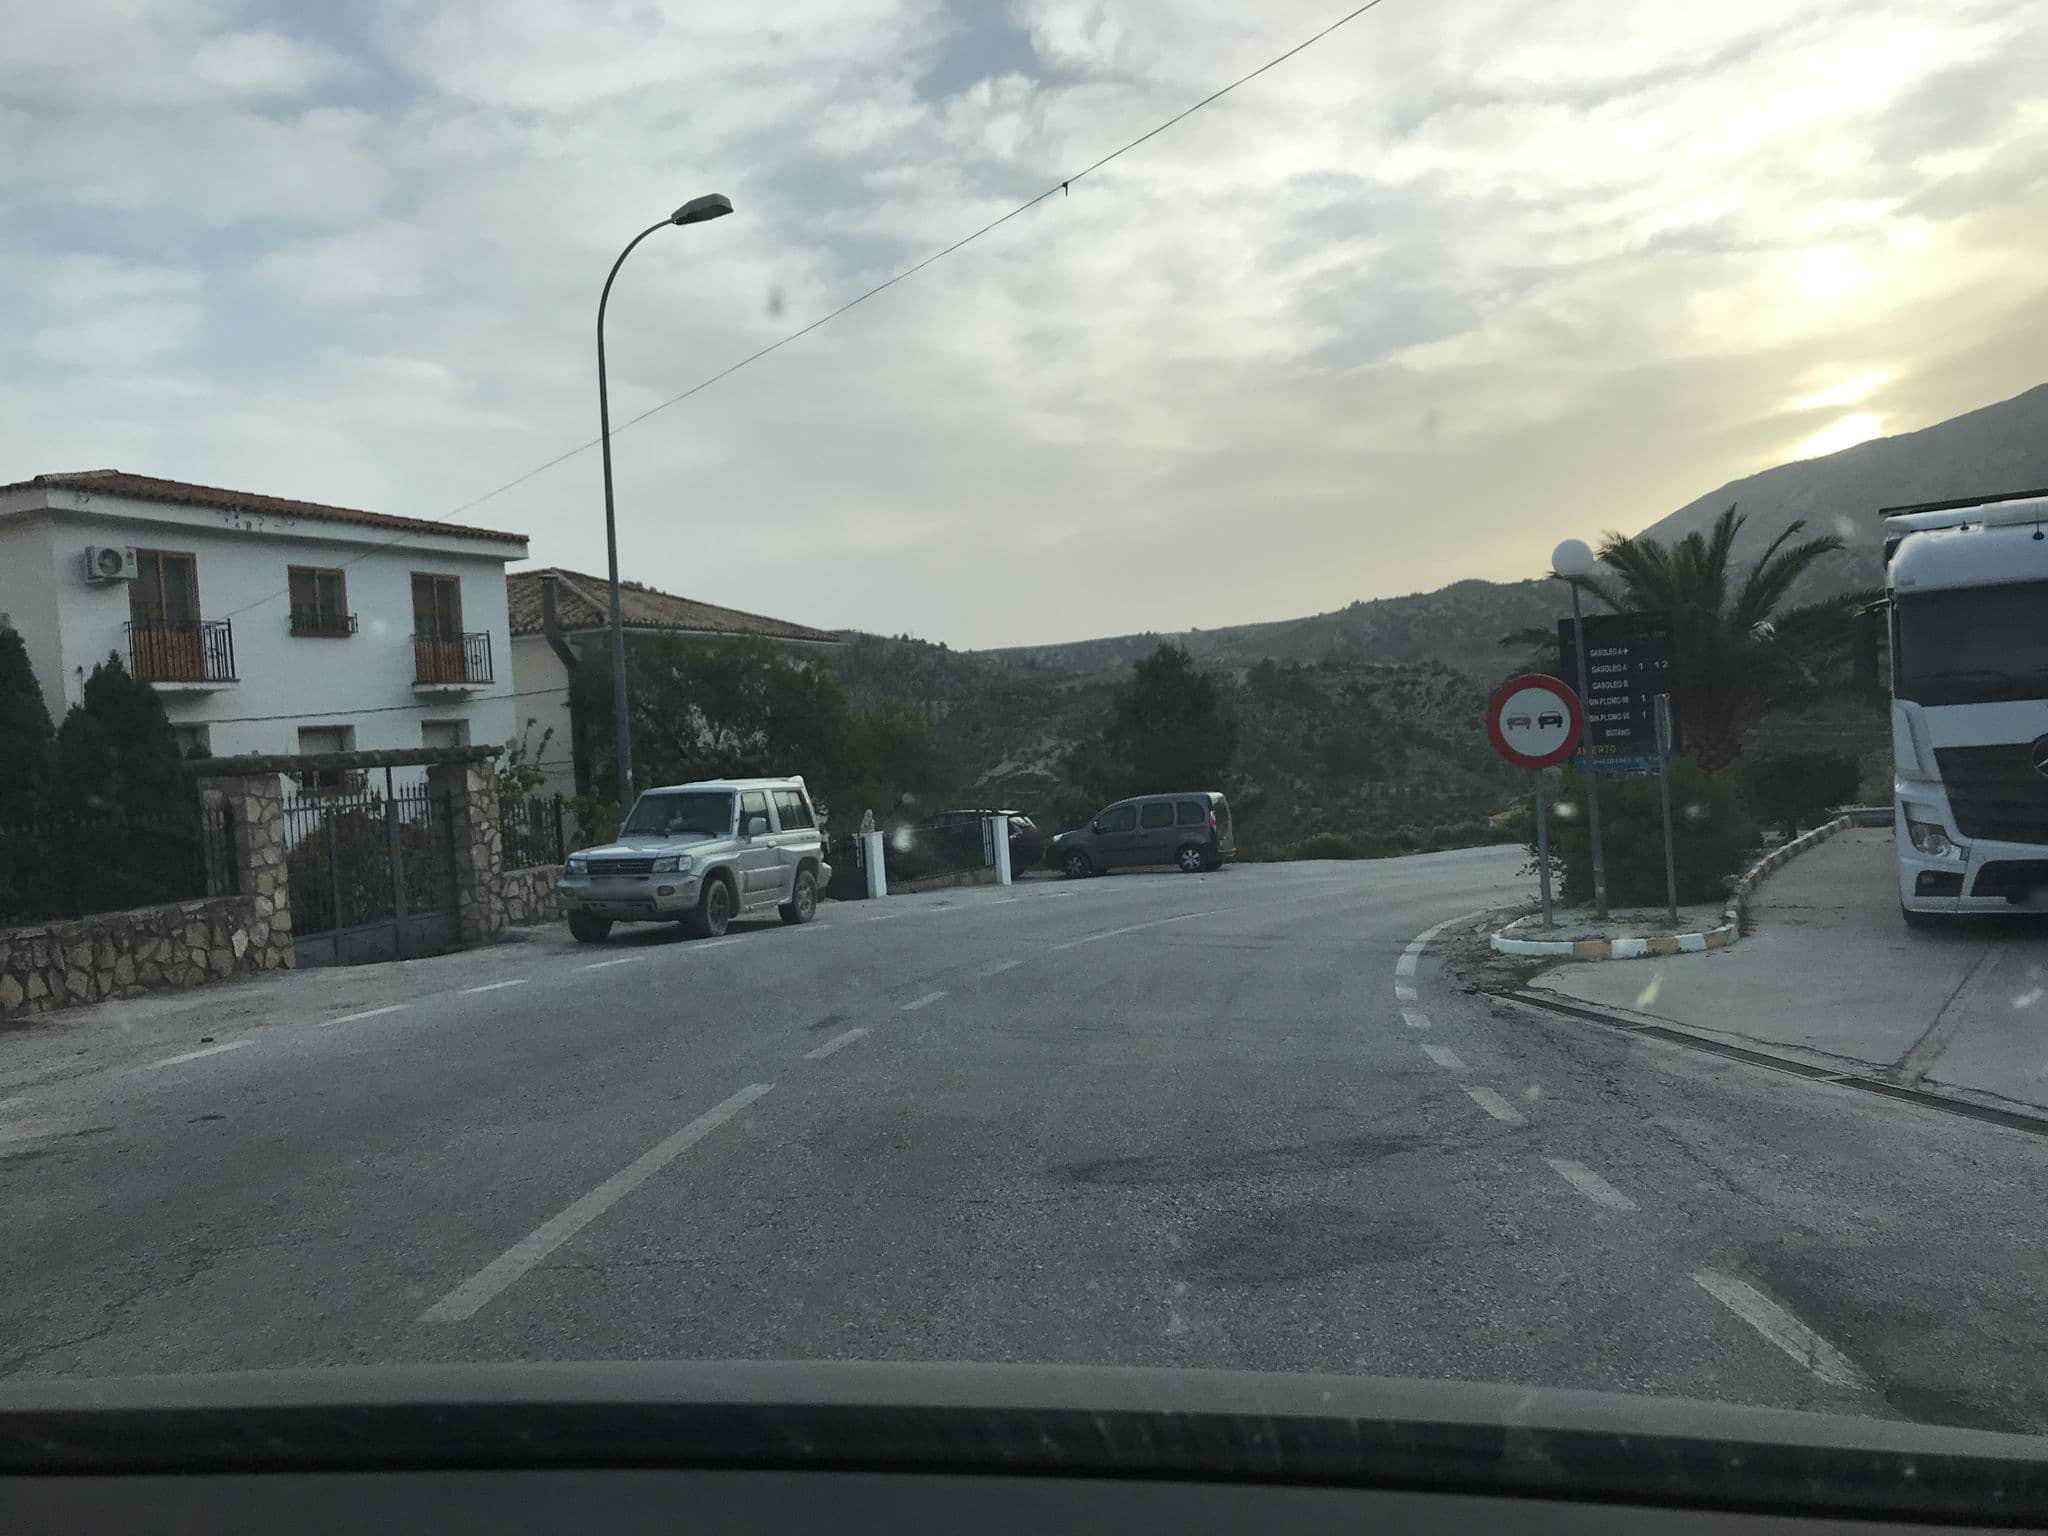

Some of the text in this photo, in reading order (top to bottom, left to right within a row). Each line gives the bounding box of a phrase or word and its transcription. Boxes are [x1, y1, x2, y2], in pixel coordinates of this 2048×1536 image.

[1590, 648, 1617, 657] GASOLEO
[1592, 664, 1621, 673] GASOLEO
[1592, 680, 1622, 690] GASOLEO
[1599, 696, 1621, 705] PLOMO
[1600, 712, 1621, 721] PLOMO
[1576, 745, 1617, 755] AERTO
